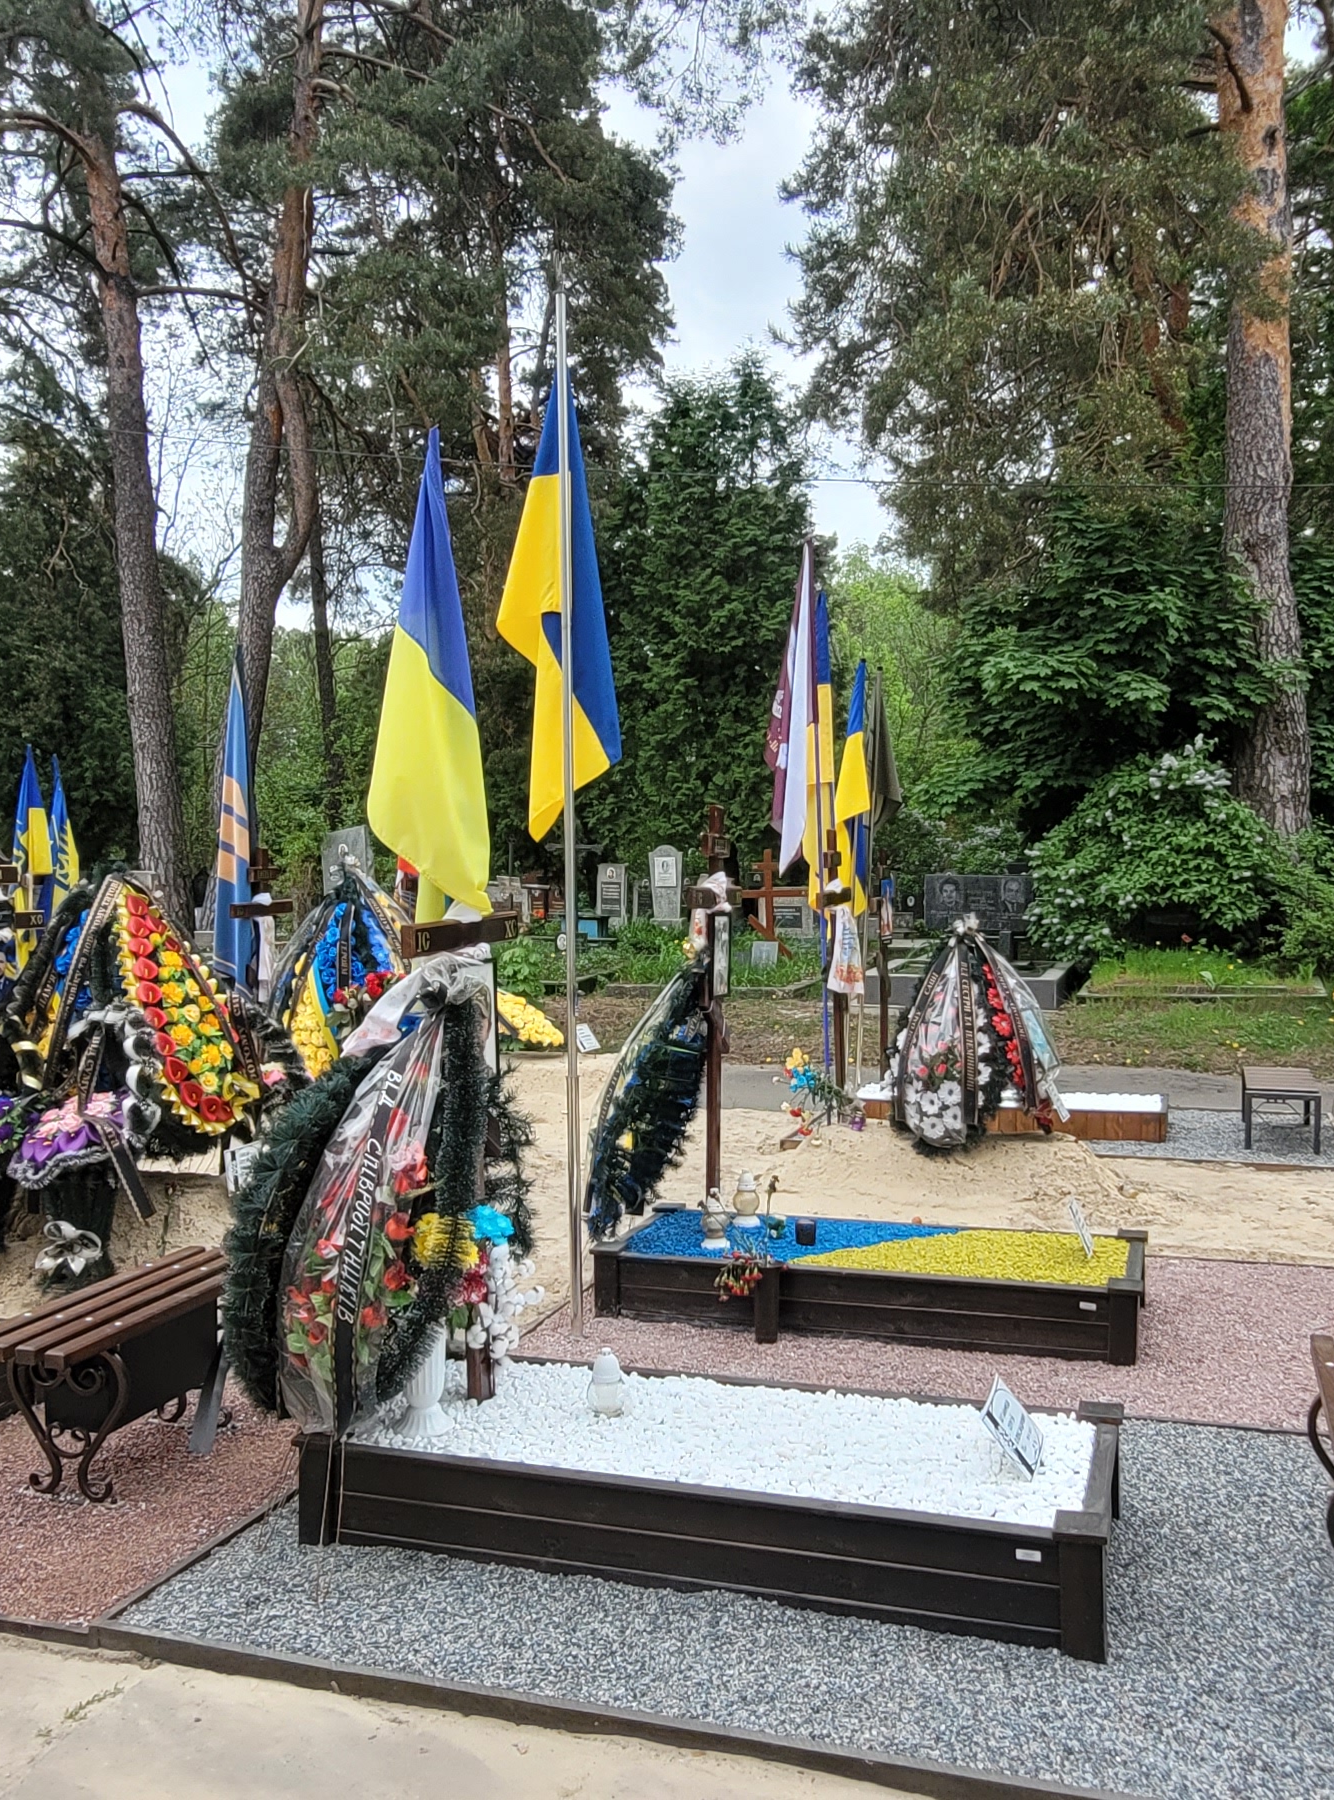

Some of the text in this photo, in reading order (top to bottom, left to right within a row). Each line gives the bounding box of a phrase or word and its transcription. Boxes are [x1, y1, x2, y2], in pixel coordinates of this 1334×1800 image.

[921, 970, 940, 996] САШІ
[960, 978, 971, 1012] СЕСТРИ
[378, 1069, 403, 1109] ВІД
